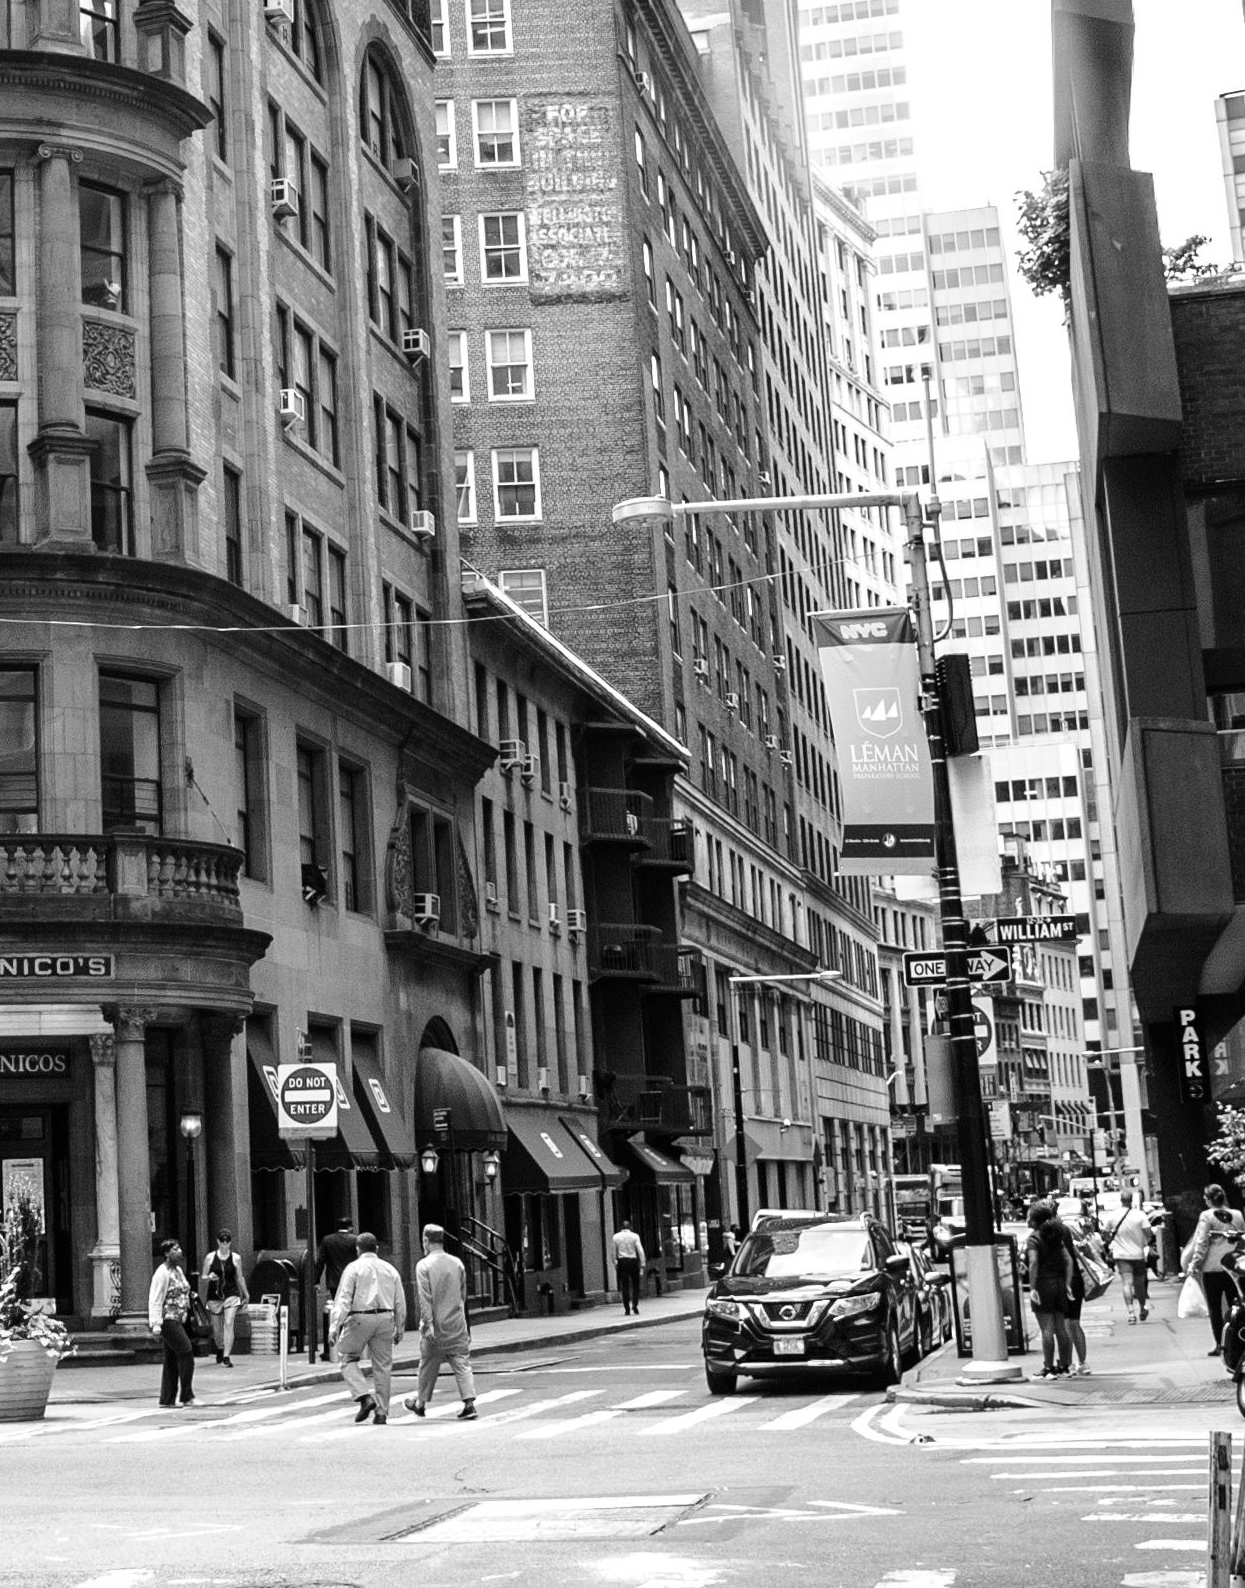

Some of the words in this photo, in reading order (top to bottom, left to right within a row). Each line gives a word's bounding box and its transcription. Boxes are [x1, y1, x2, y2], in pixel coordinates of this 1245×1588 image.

[839, 622, 888, 639] NYC
[850, 740, 919, 763] LÉMAN
[852, 763, 919, 773] MANHATTAN
[1000, 922, 1062, 940] WILLIAM
[1062, 922, 1074, 931] ST
[914, 962, 944, 976] ONE
[1180, 1009, 1203, 1077] PARK
[289, 1078, 303, 1088] DO
[306, 1077, 326, 1087] NOT
[290, 1103, 325, 1115] ENTER
